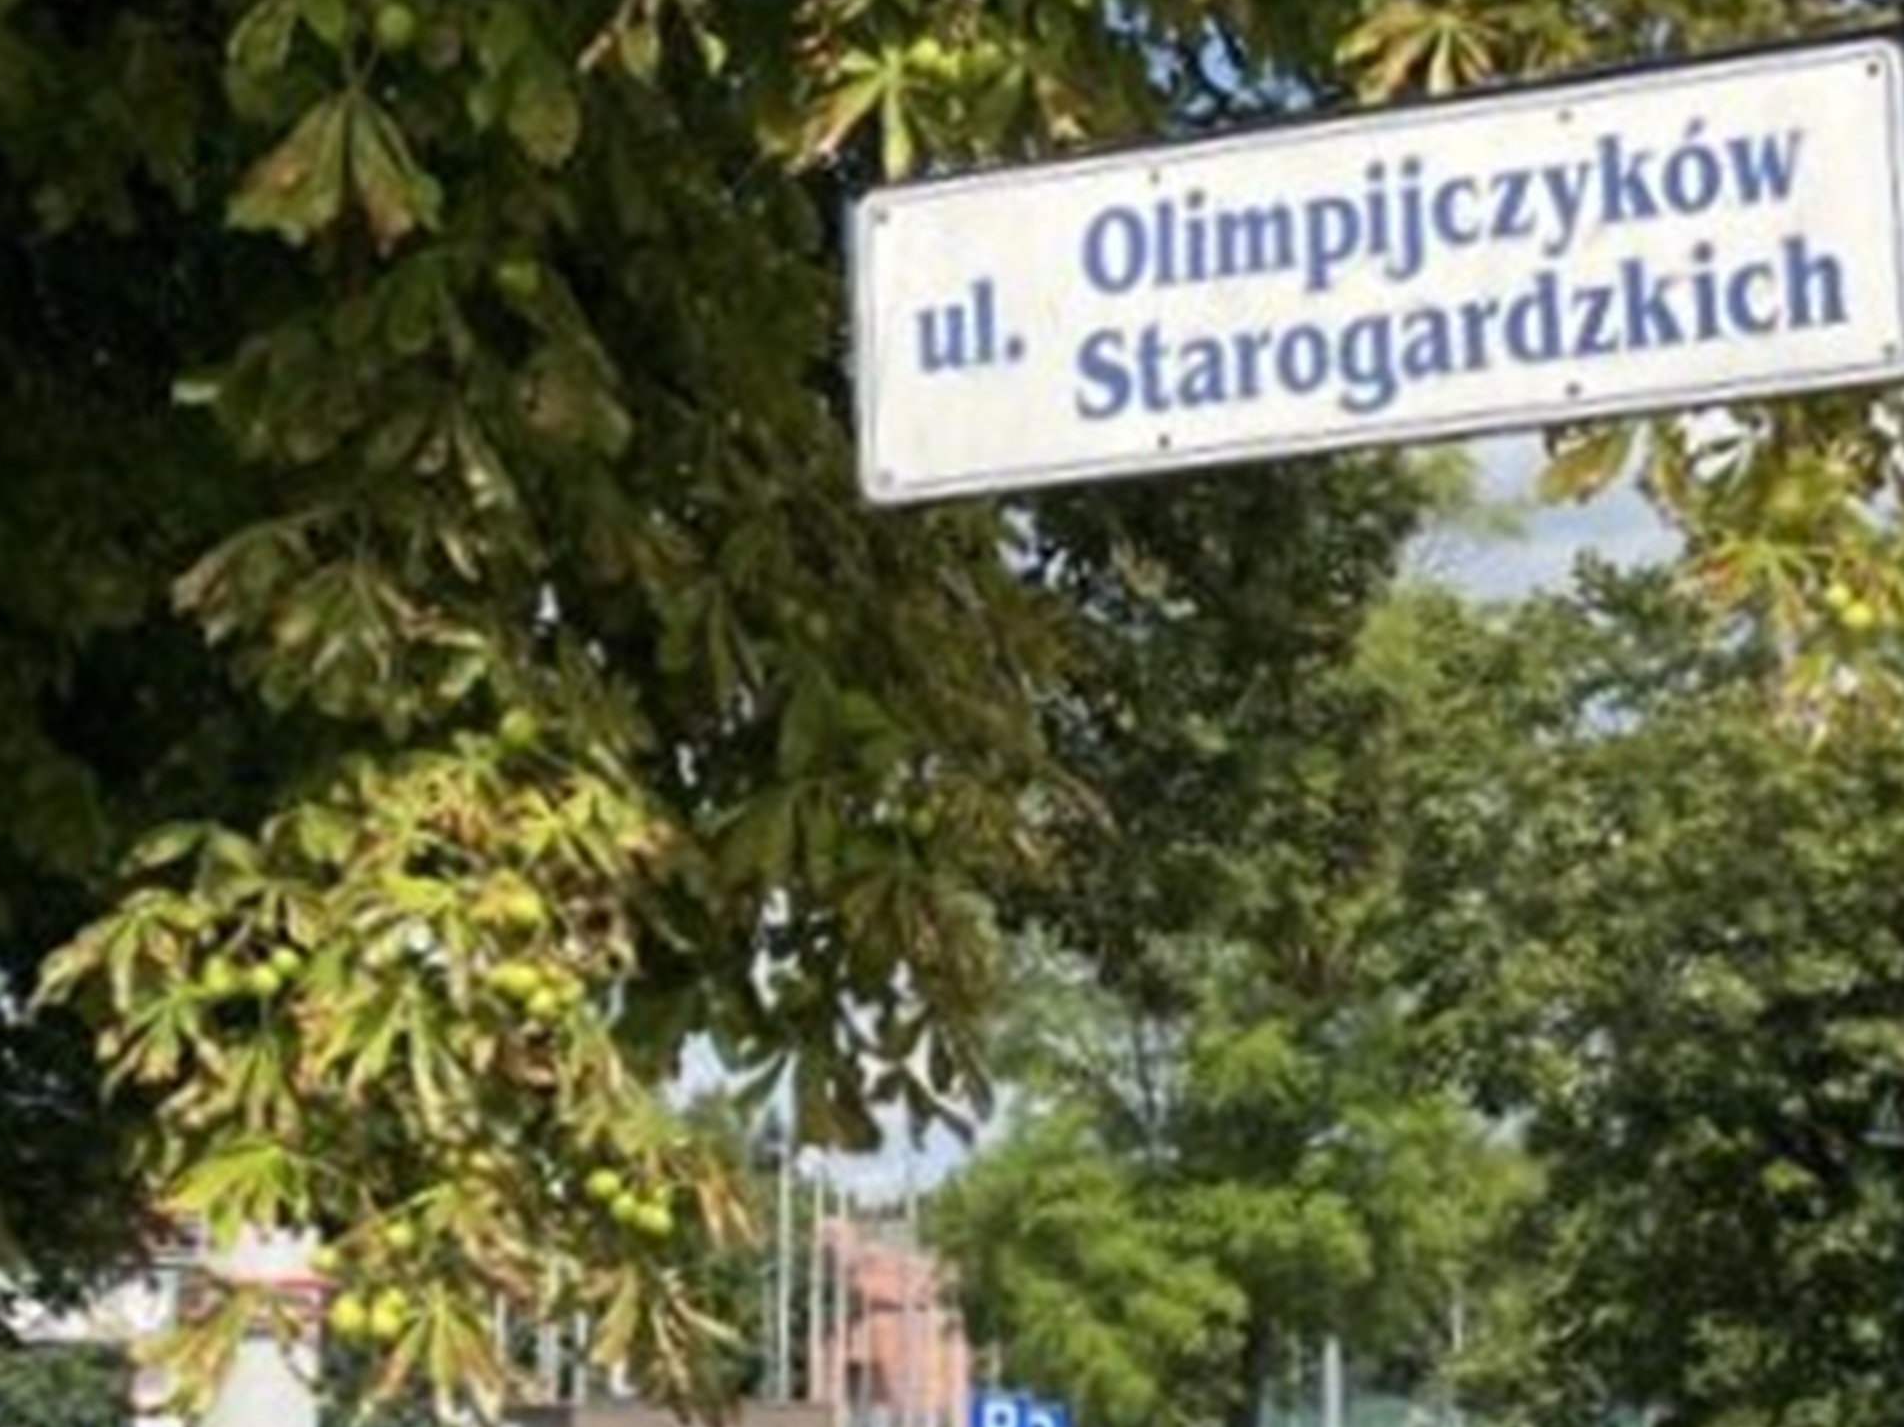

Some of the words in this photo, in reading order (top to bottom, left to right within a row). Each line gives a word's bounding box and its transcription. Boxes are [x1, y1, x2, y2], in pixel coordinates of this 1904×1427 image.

[1080, 120, 1804, 297] Olimpijczyków
[916, 279, 1024, 373] ul.
[1074, 237, 1846, 421] Starogardzkich
